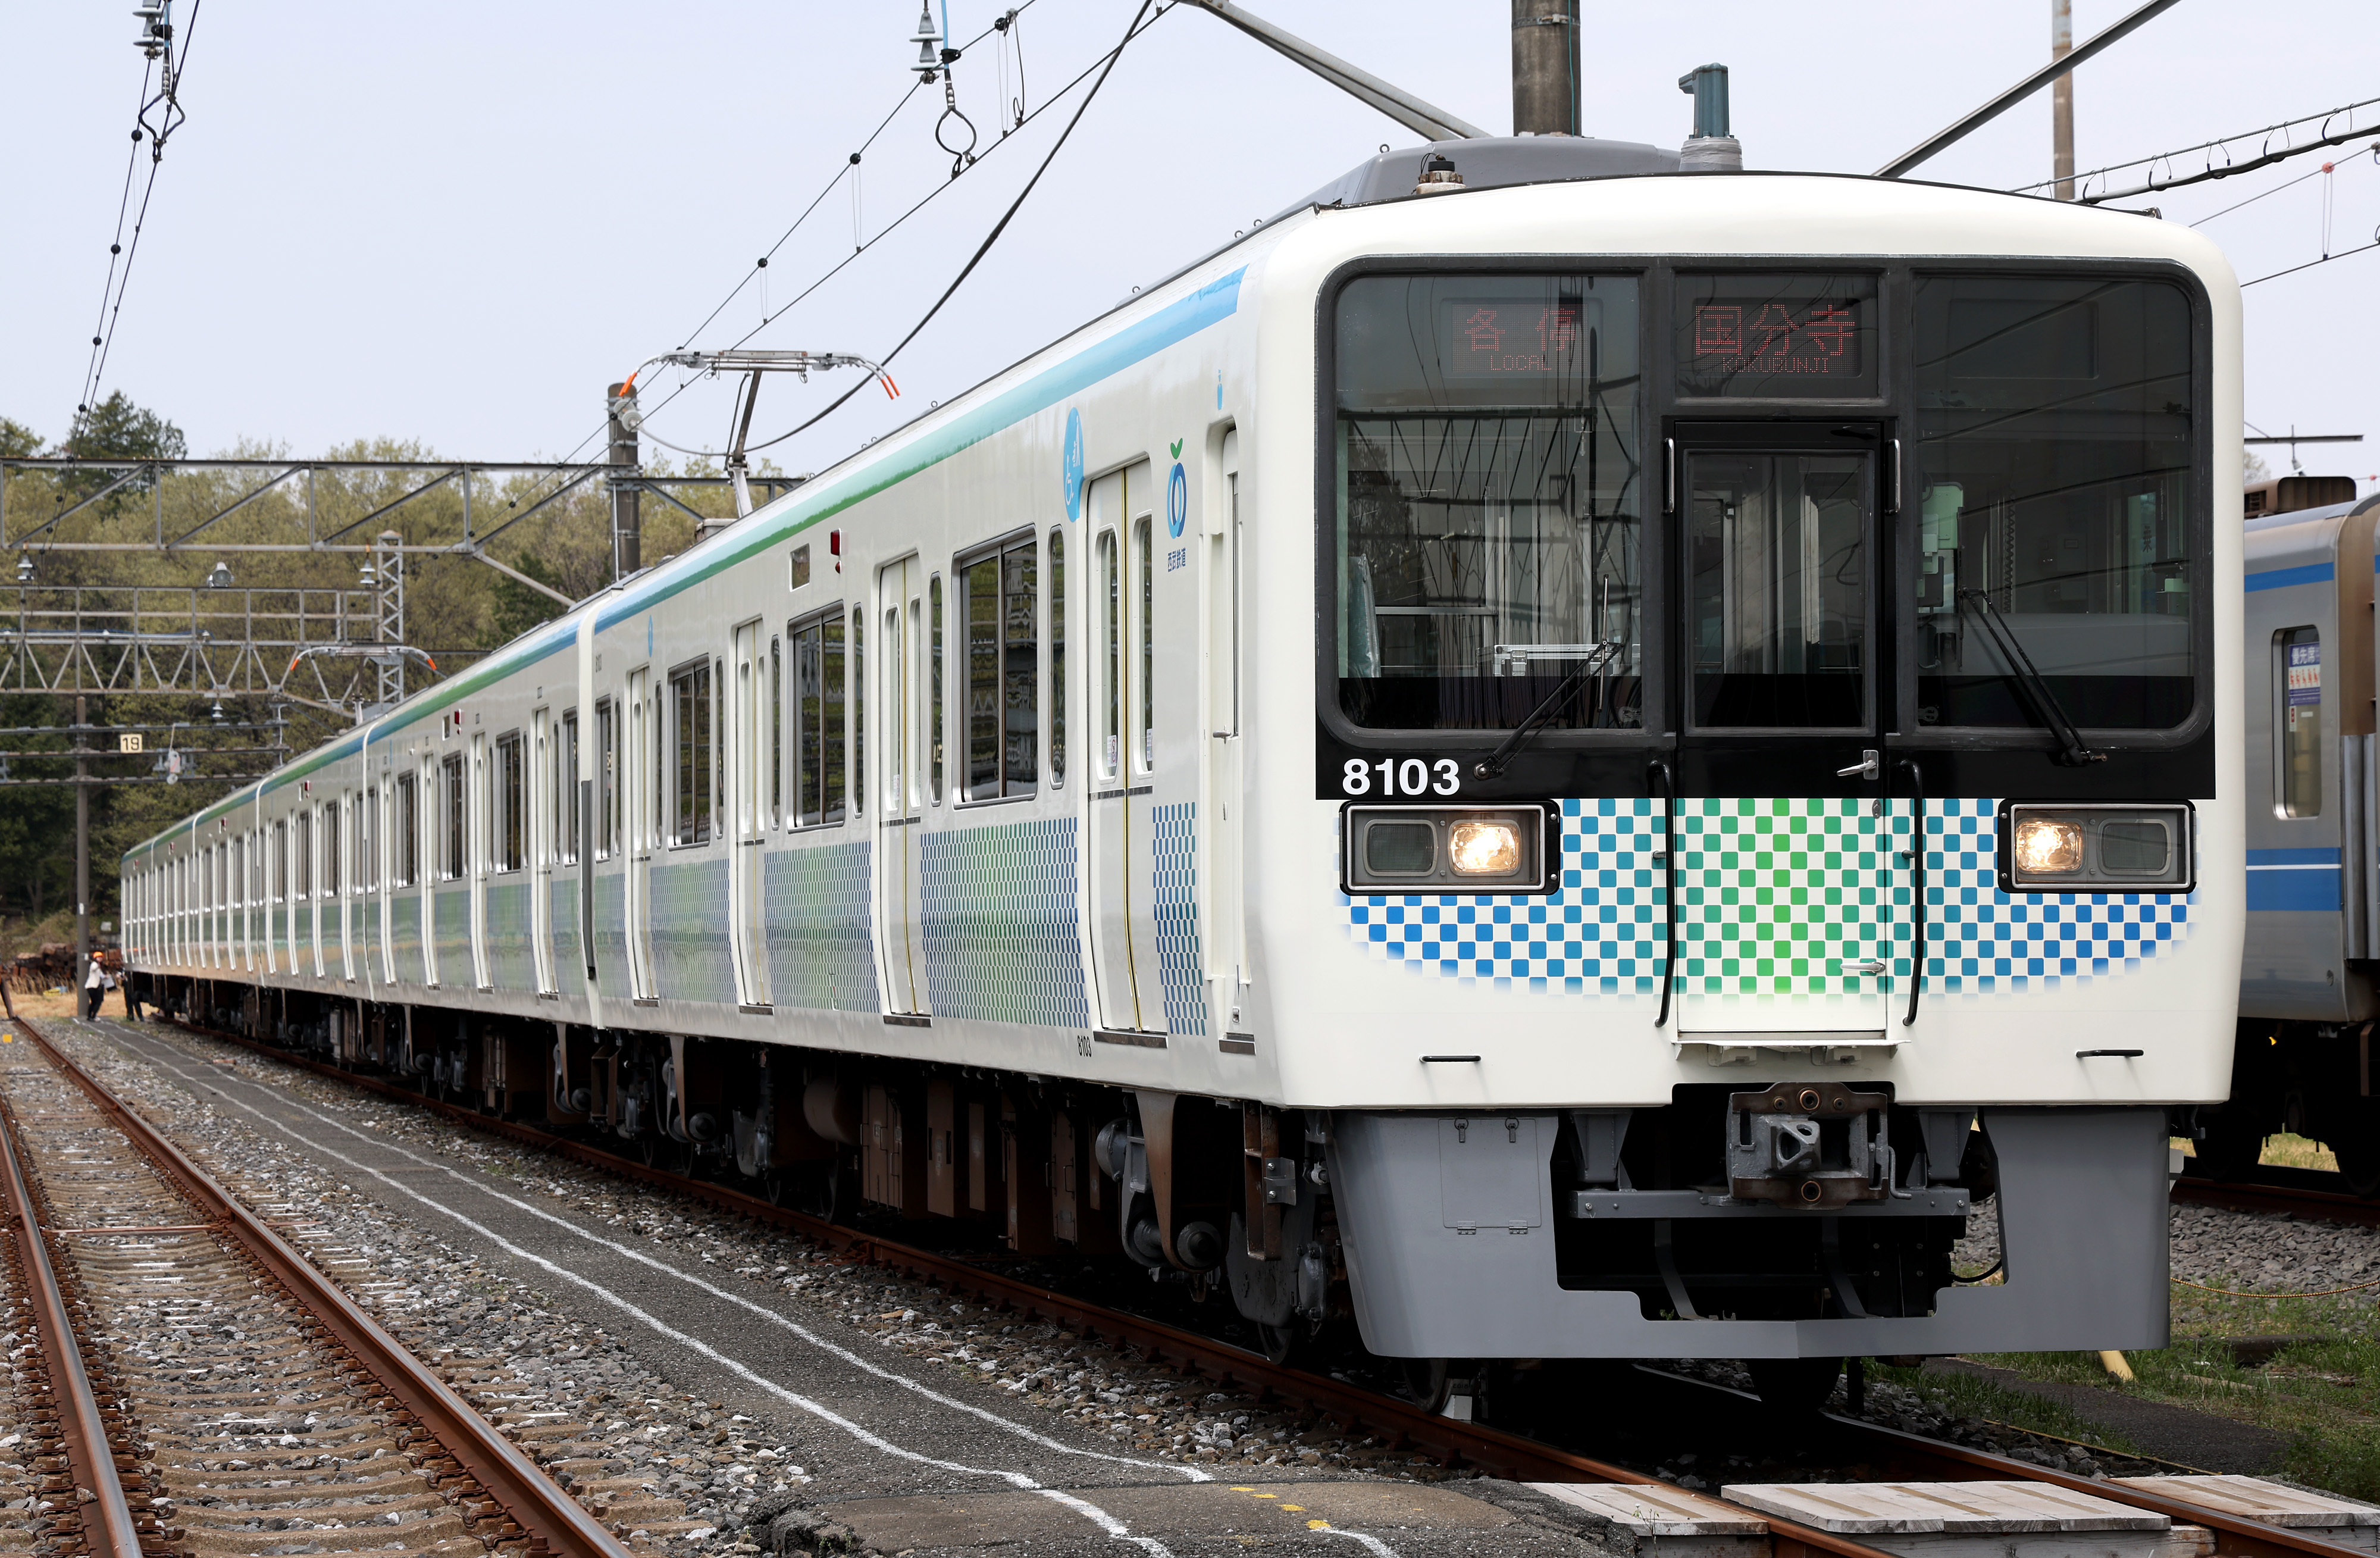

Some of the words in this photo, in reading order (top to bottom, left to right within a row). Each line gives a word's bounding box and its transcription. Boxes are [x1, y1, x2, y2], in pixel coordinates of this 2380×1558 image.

[1465, 308, 1576, 351] 各停
[1696, 304, 1855, 356] 国分寺
[1490, 355, 1552, 371] LOCAL
[1723, 358, 1828, 373] KOKUBUNJI
[1168, 547, 1186, 572] 西武鉄道
[2291, 646, 2316, 666] 優先席
[123, 737, 140, 750] 19
[1342, 758, 1460, 796] 8103
[1077, 1035, 1092, 1058] 8103
